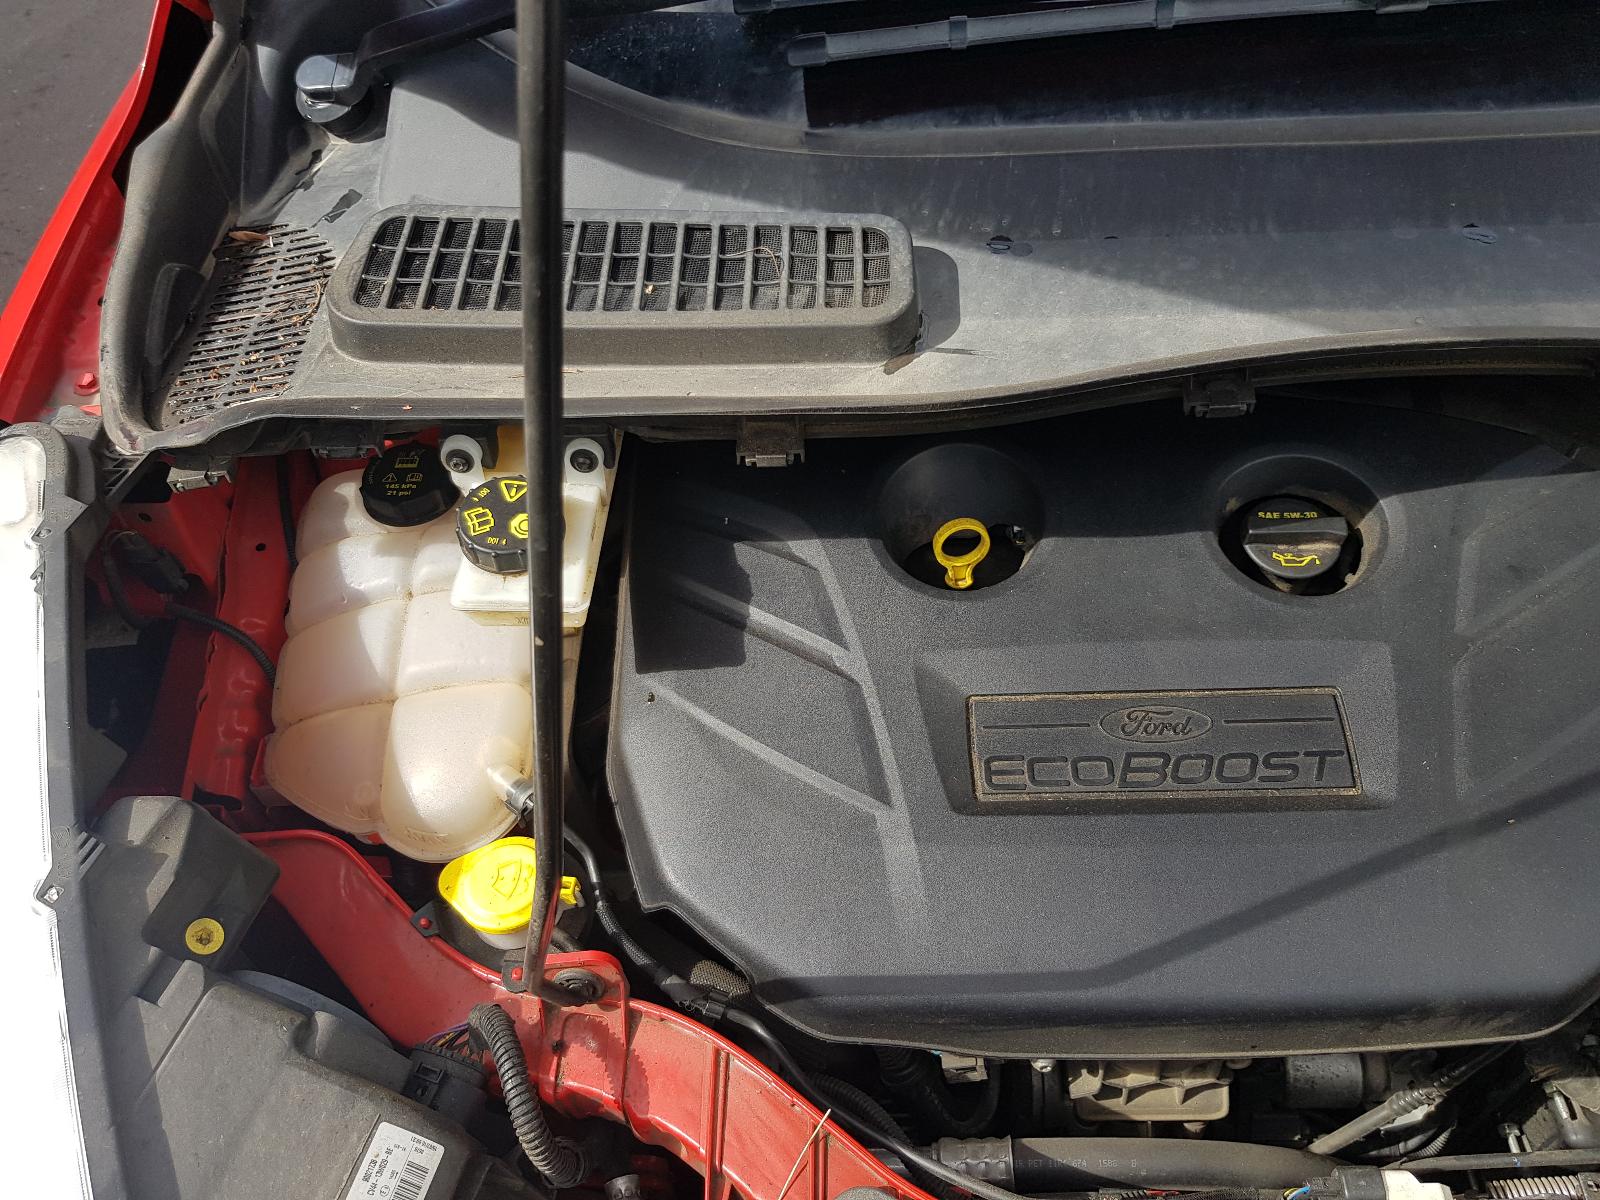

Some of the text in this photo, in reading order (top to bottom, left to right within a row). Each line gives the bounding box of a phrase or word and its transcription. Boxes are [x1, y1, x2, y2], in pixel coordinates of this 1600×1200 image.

[399, 489, 412, 497] psi
[1257, 511, 1318, 519] SAE 5W-30
[487, 536, 499, 545] DOT
[1119, 708, 1193, 738] Ford
